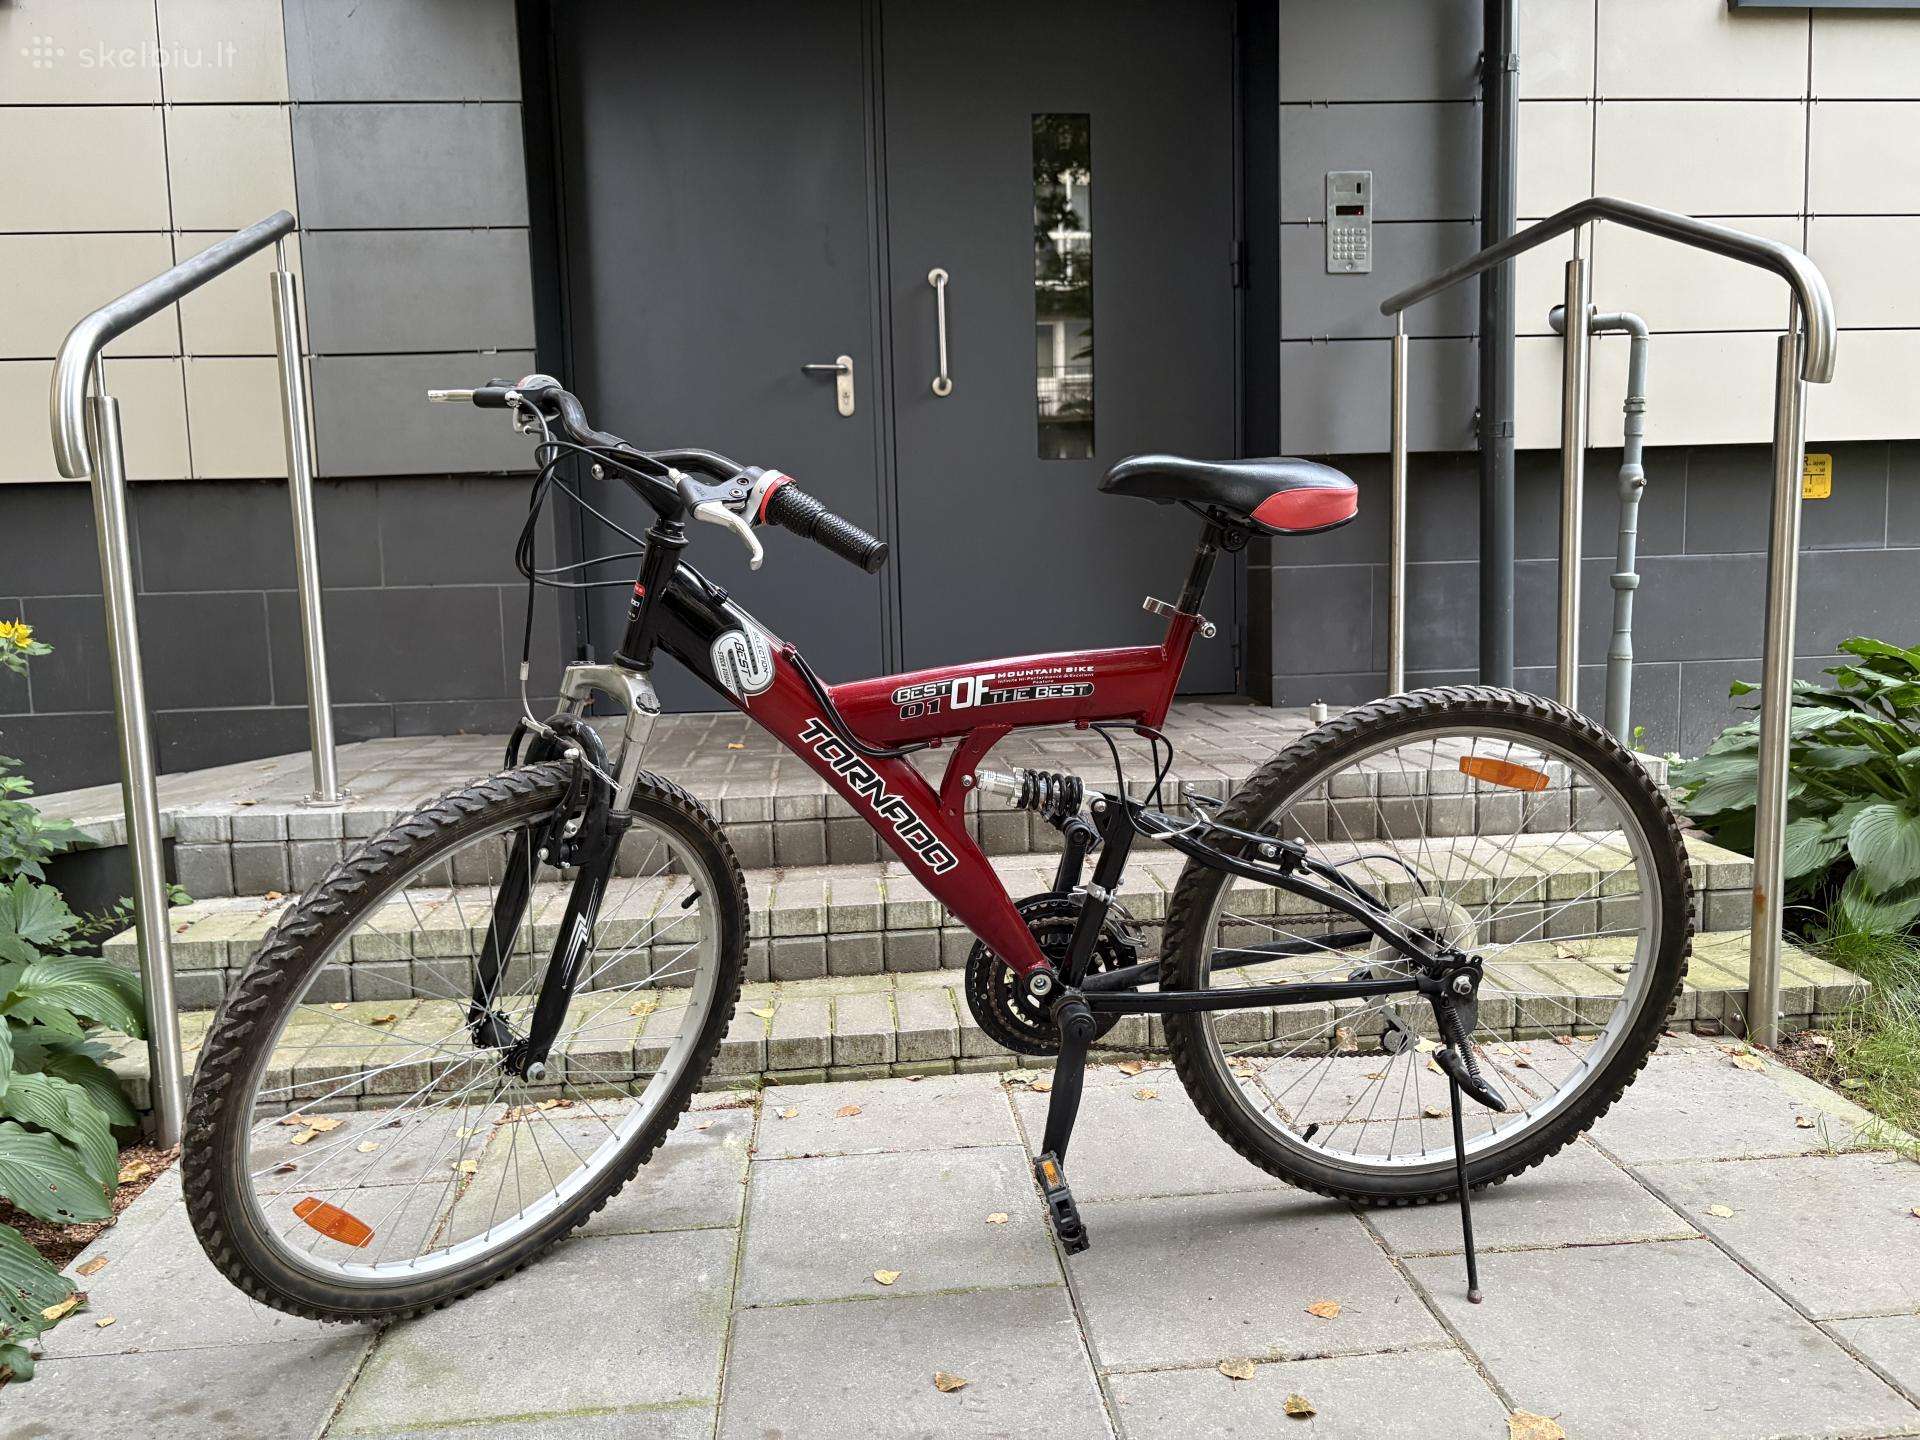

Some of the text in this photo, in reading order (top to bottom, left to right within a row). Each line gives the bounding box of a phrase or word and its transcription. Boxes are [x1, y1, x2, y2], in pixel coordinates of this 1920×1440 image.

[734, 641, 752, 678] BEST
[997, 665, 1094, 679] MOUNTAIN BIKE
[896, 673, 1089, 710] BEST OF THE BEST
[900, 698, 941, 720] 01
